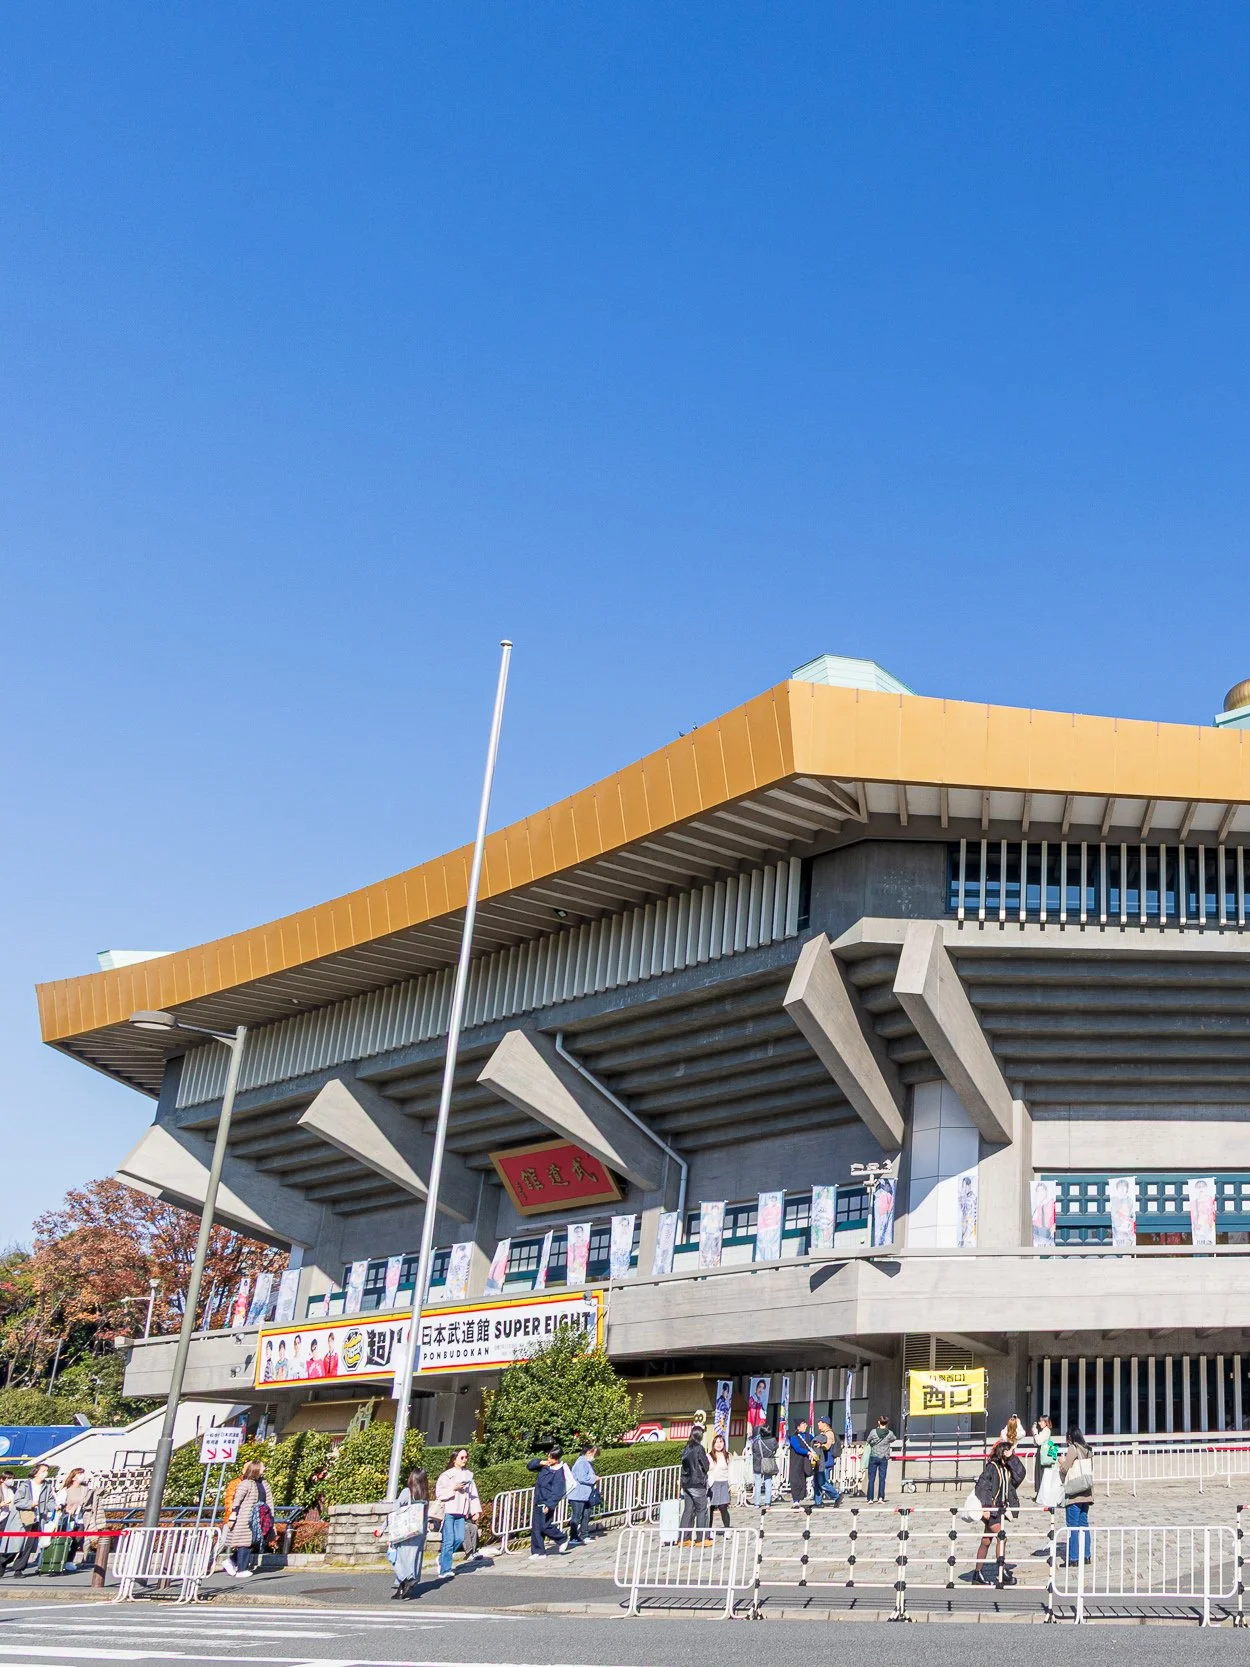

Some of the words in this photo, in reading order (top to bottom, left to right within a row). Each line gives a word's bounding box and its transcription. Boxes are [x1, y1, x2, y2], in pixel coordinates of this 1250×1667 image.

[421, 1318, 490, 1347] 日本武道館
[494, 1316, 540, 1340] SUPER
[922, 1384, 972, 1410] 西口
